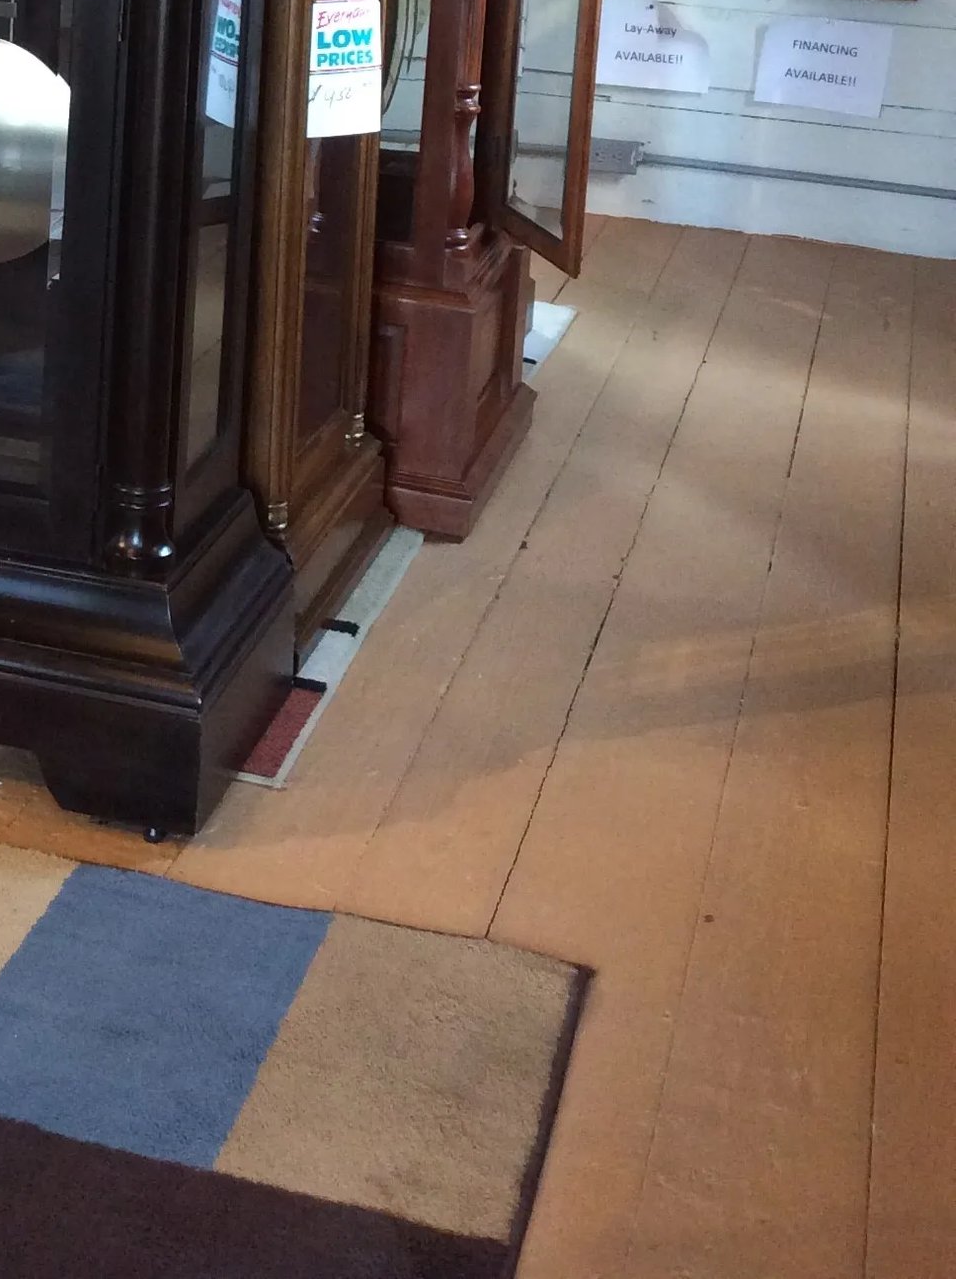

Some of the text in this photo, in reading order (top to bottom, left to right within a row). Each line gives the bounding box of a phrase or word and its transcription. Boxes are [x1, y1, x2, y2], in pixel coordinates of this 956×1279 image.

[317, 27, 373, 50] LOW
[624, 22, 677, 38] Lay-Away
[792, 39, 859, 58] FINANCING
[317, 50, 373, 67] PRICES
[614, 51, 684, 65] AVAILABLE!!
[784, 67, 857, 87] AVAILABLE!!
